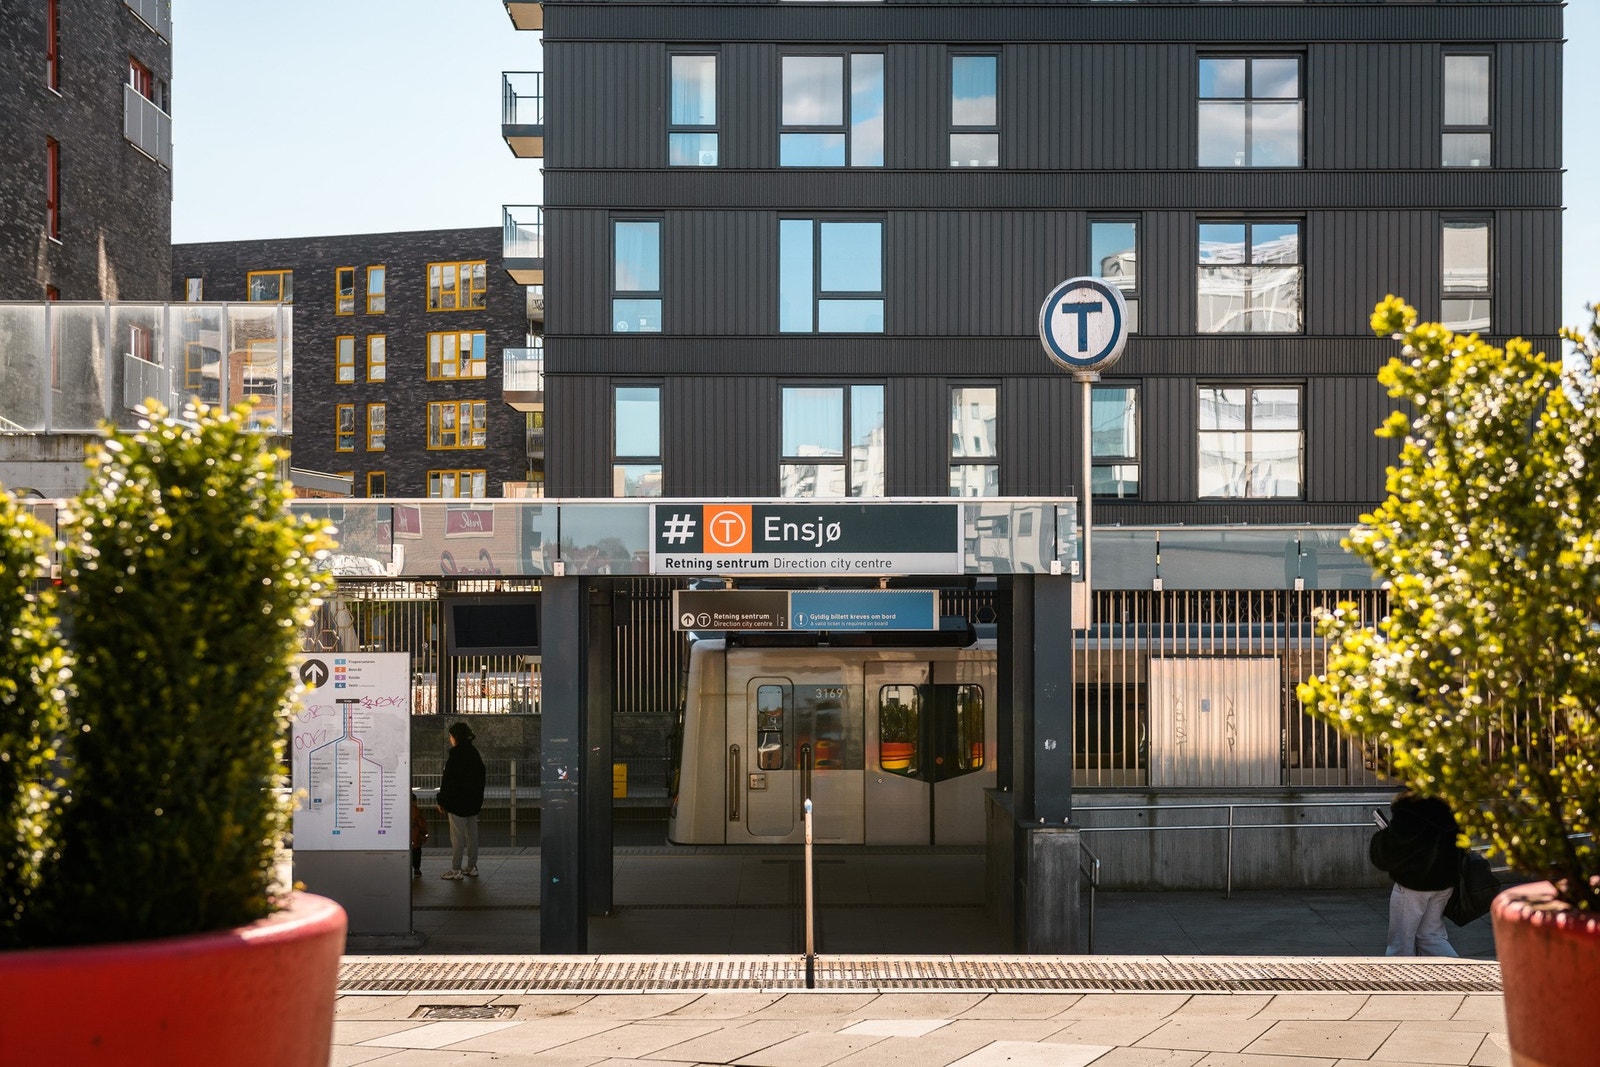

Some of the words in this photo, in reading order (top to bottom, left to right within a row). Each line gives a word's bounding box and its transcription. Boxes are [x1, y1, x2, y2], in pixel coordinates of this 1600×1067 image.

[1061, 301, 1103, 353] T
[764, 516, 841, 548] Ensjø
[665, 557, 713, 571] Retning
[716, 558, 769, 569] sentrum
[773, 557, 827, 569] Direction
[830, 557, 852, 571] city
[854, 558, 892, 569] centre
[713, 612, 740, 620] Retning
[810, 613, 830, 621] Gyldig
[742, 620, 752, 628] city
[815, 688, 843, 699] 3169
